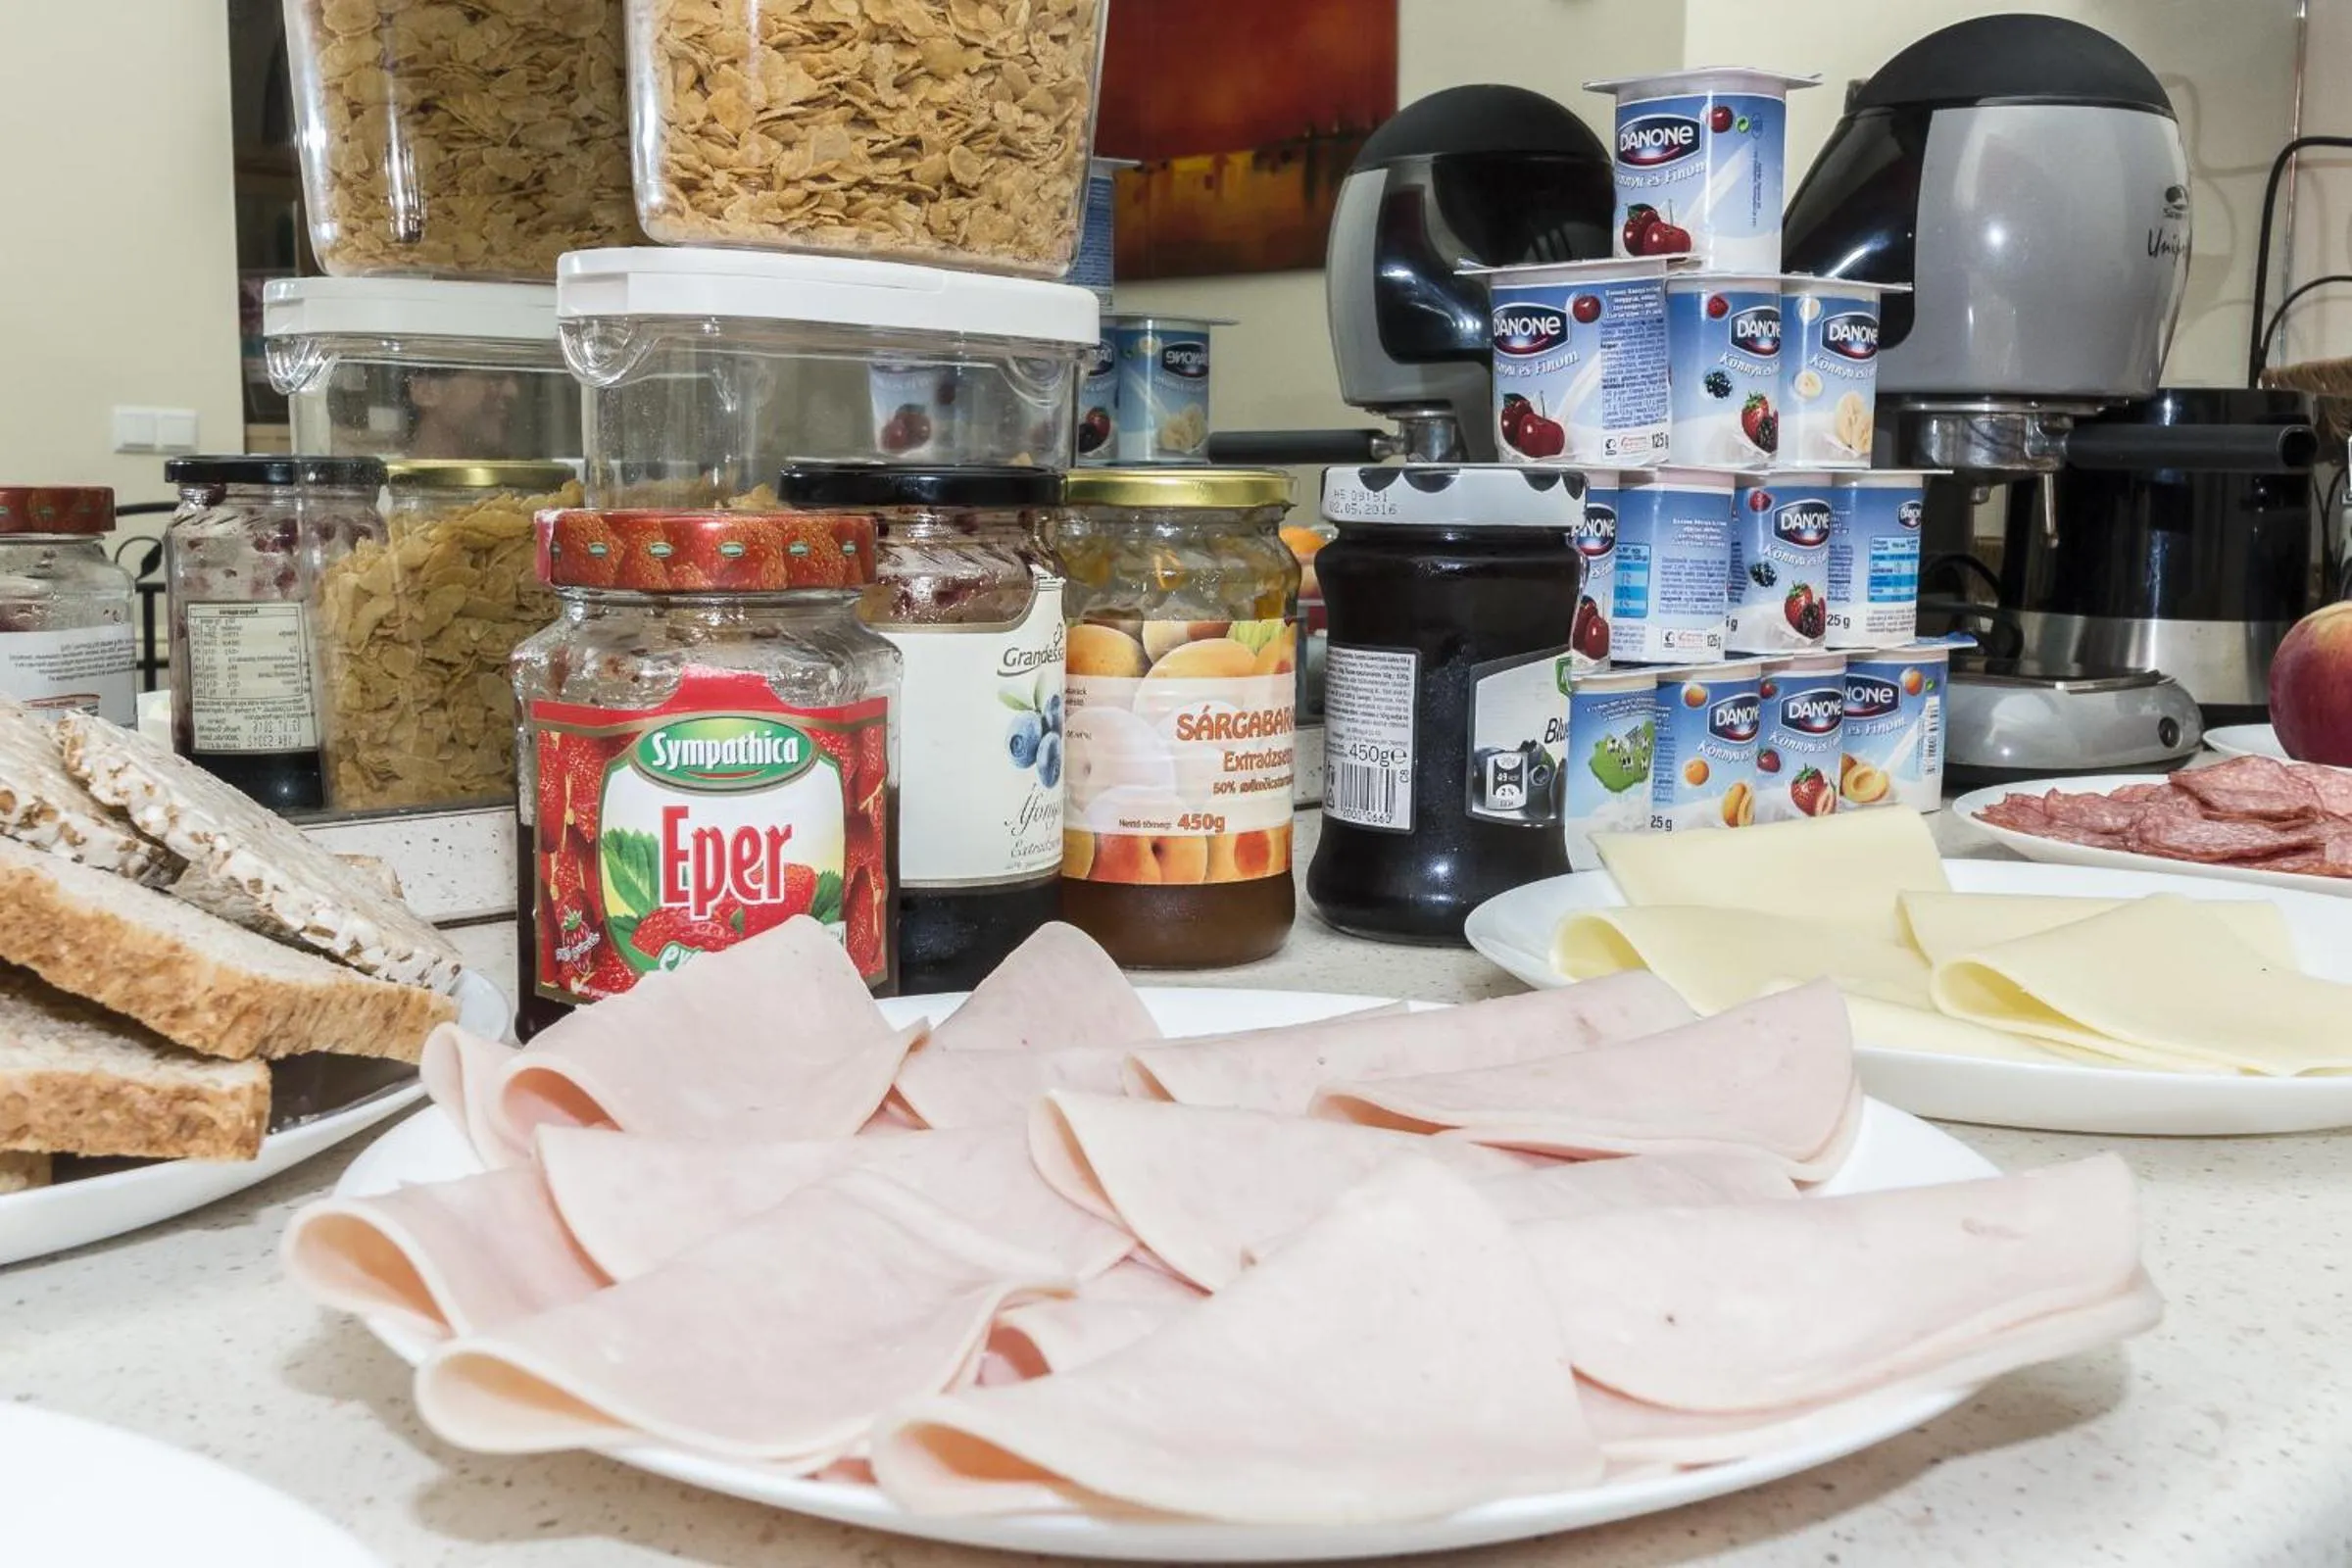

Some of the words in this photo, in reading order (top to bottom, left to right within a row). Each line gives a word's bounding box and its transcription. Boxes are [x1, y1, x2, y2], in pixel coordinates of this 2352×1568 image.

[1619, 125, 1694, 152] DANONE
[1493, 316, 1561, 337] DANONE
[651, 729, 800, 771] Sympathica
[1177, 812, 1226, 833] 450g
[660, 805, 793, 920] Eper
